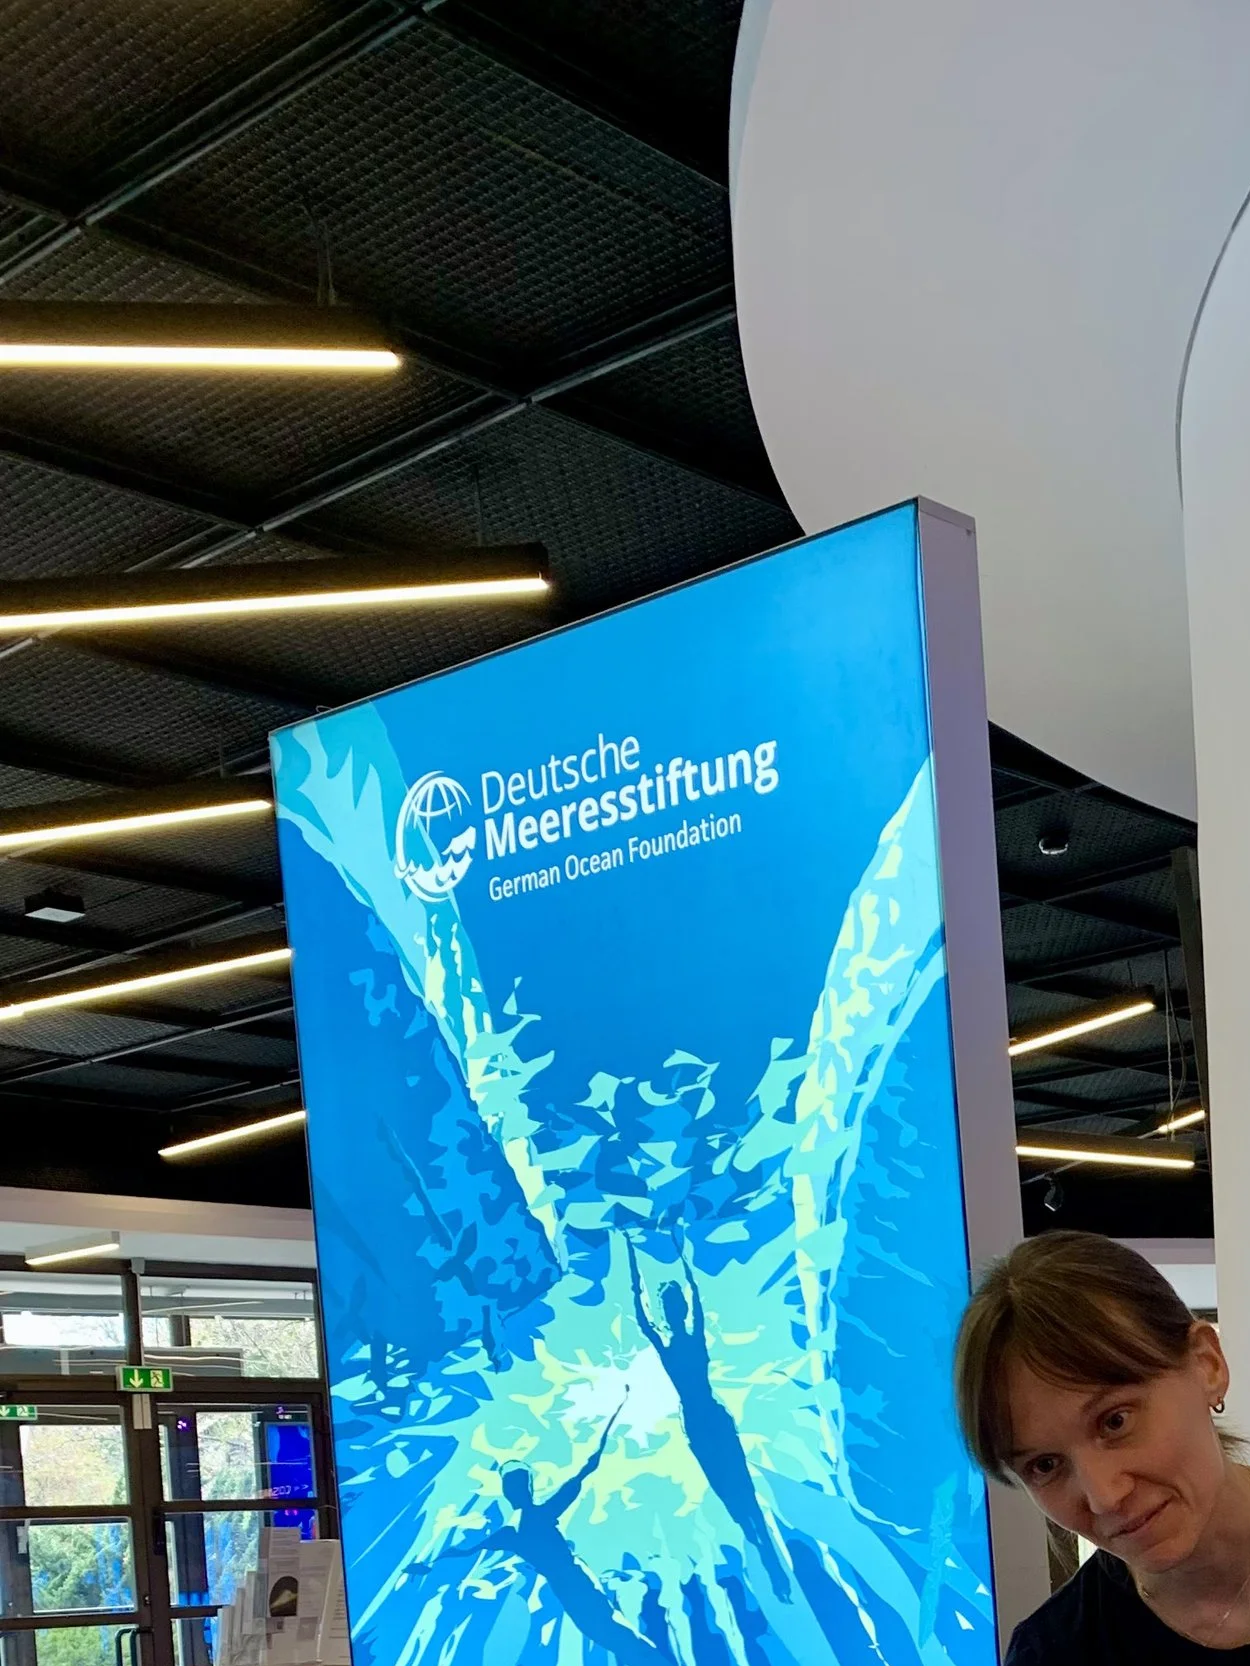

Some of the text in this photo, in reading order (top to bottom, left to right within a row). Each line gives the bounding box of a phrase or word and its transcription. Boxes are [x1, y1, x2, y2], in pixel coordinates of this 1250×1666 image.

[480, 733, 640, 815] Deutsche
[484, 740, 780, 861] Meeresstiftung
[488, 812, 742, 901] German Ocean Foundation
